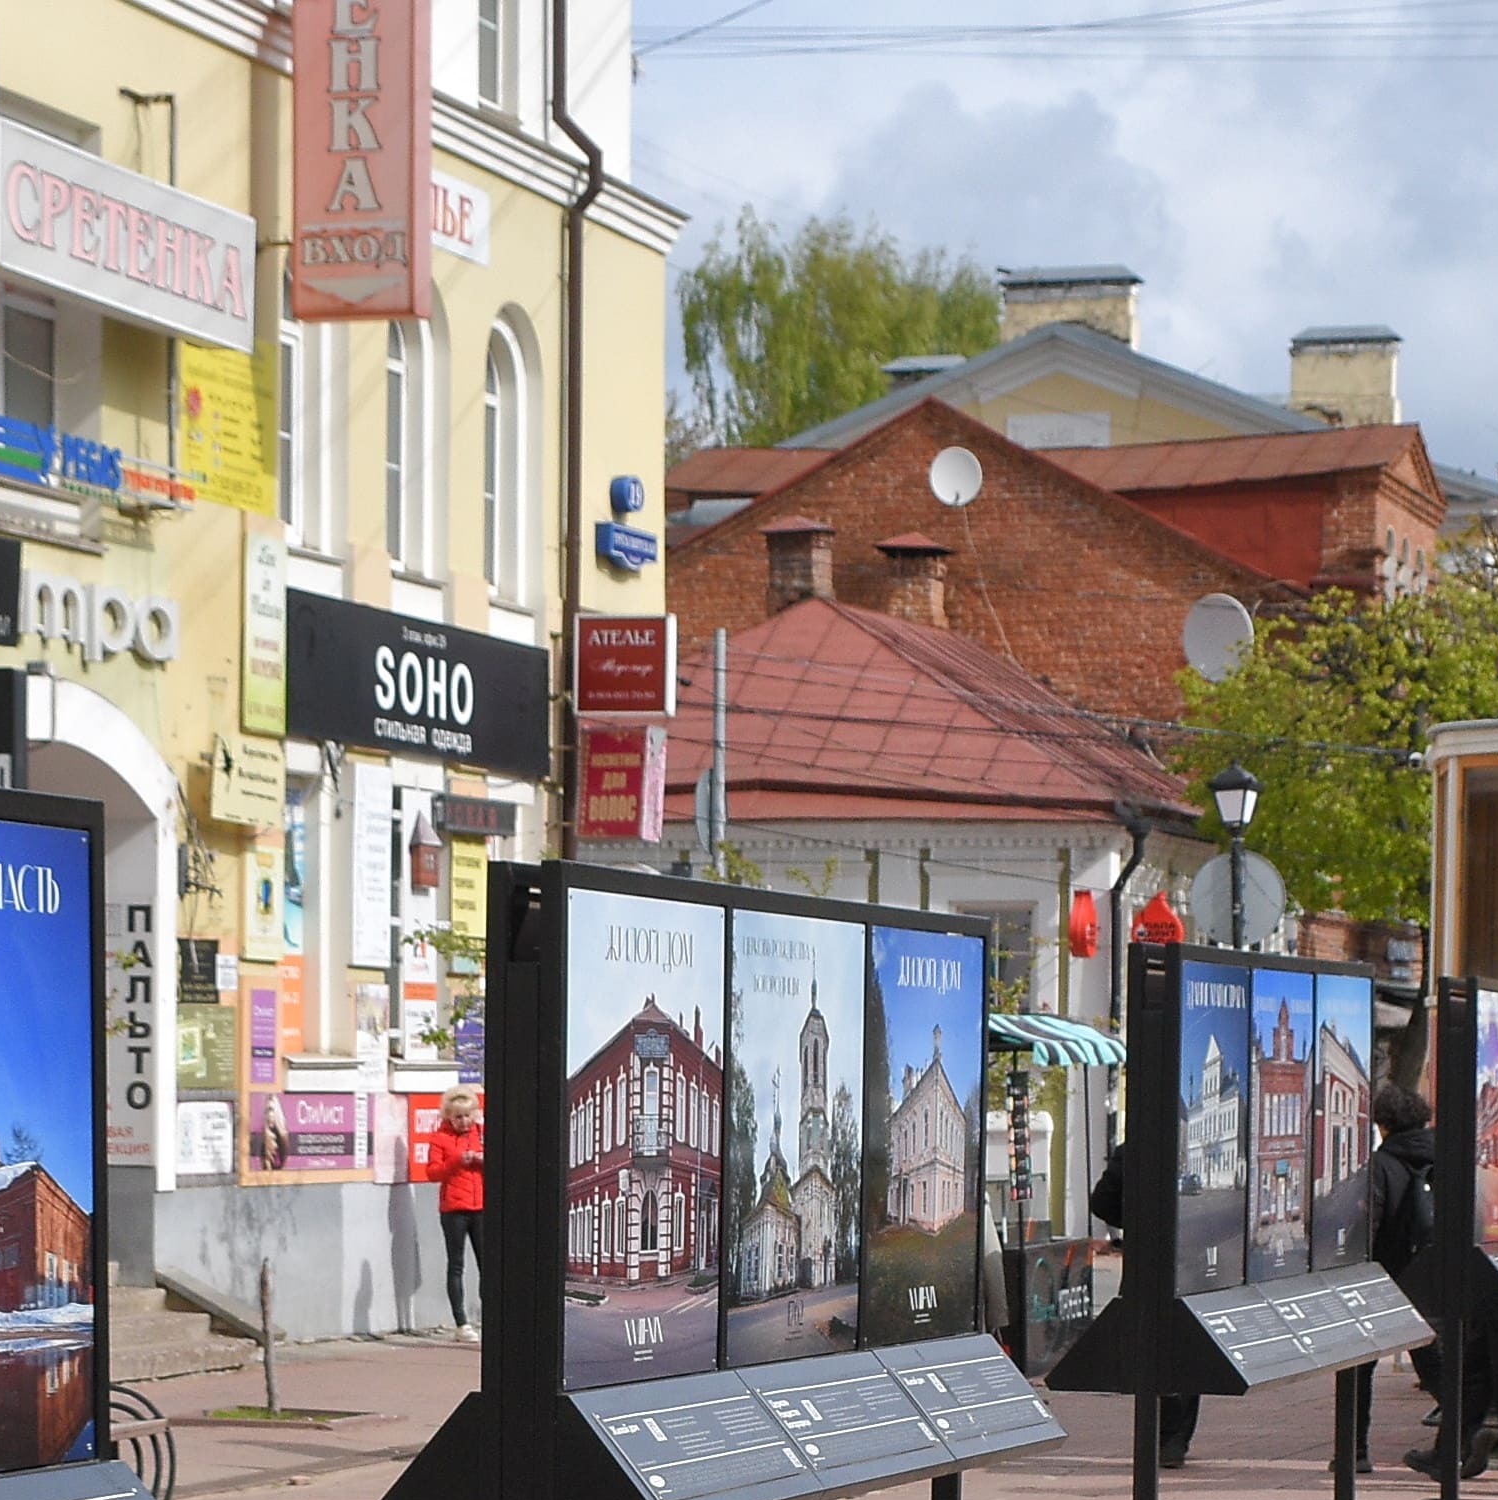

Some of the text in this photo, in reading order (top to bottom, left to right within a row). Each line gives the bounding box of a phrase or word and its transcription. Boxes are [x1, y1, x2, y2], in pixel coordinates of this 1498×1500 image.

[6, 160, 247, 321] СРЕТЕНКА
[302, 231, 407, 268] ВХОД
[588, 629, 656, 646] АТЕЛЬЕ
[374, 645, 474, 725] SOHO
[662, 931, 693, 973] ДОМ
[126, 905, 152, 1110] ПАЛЬТО
